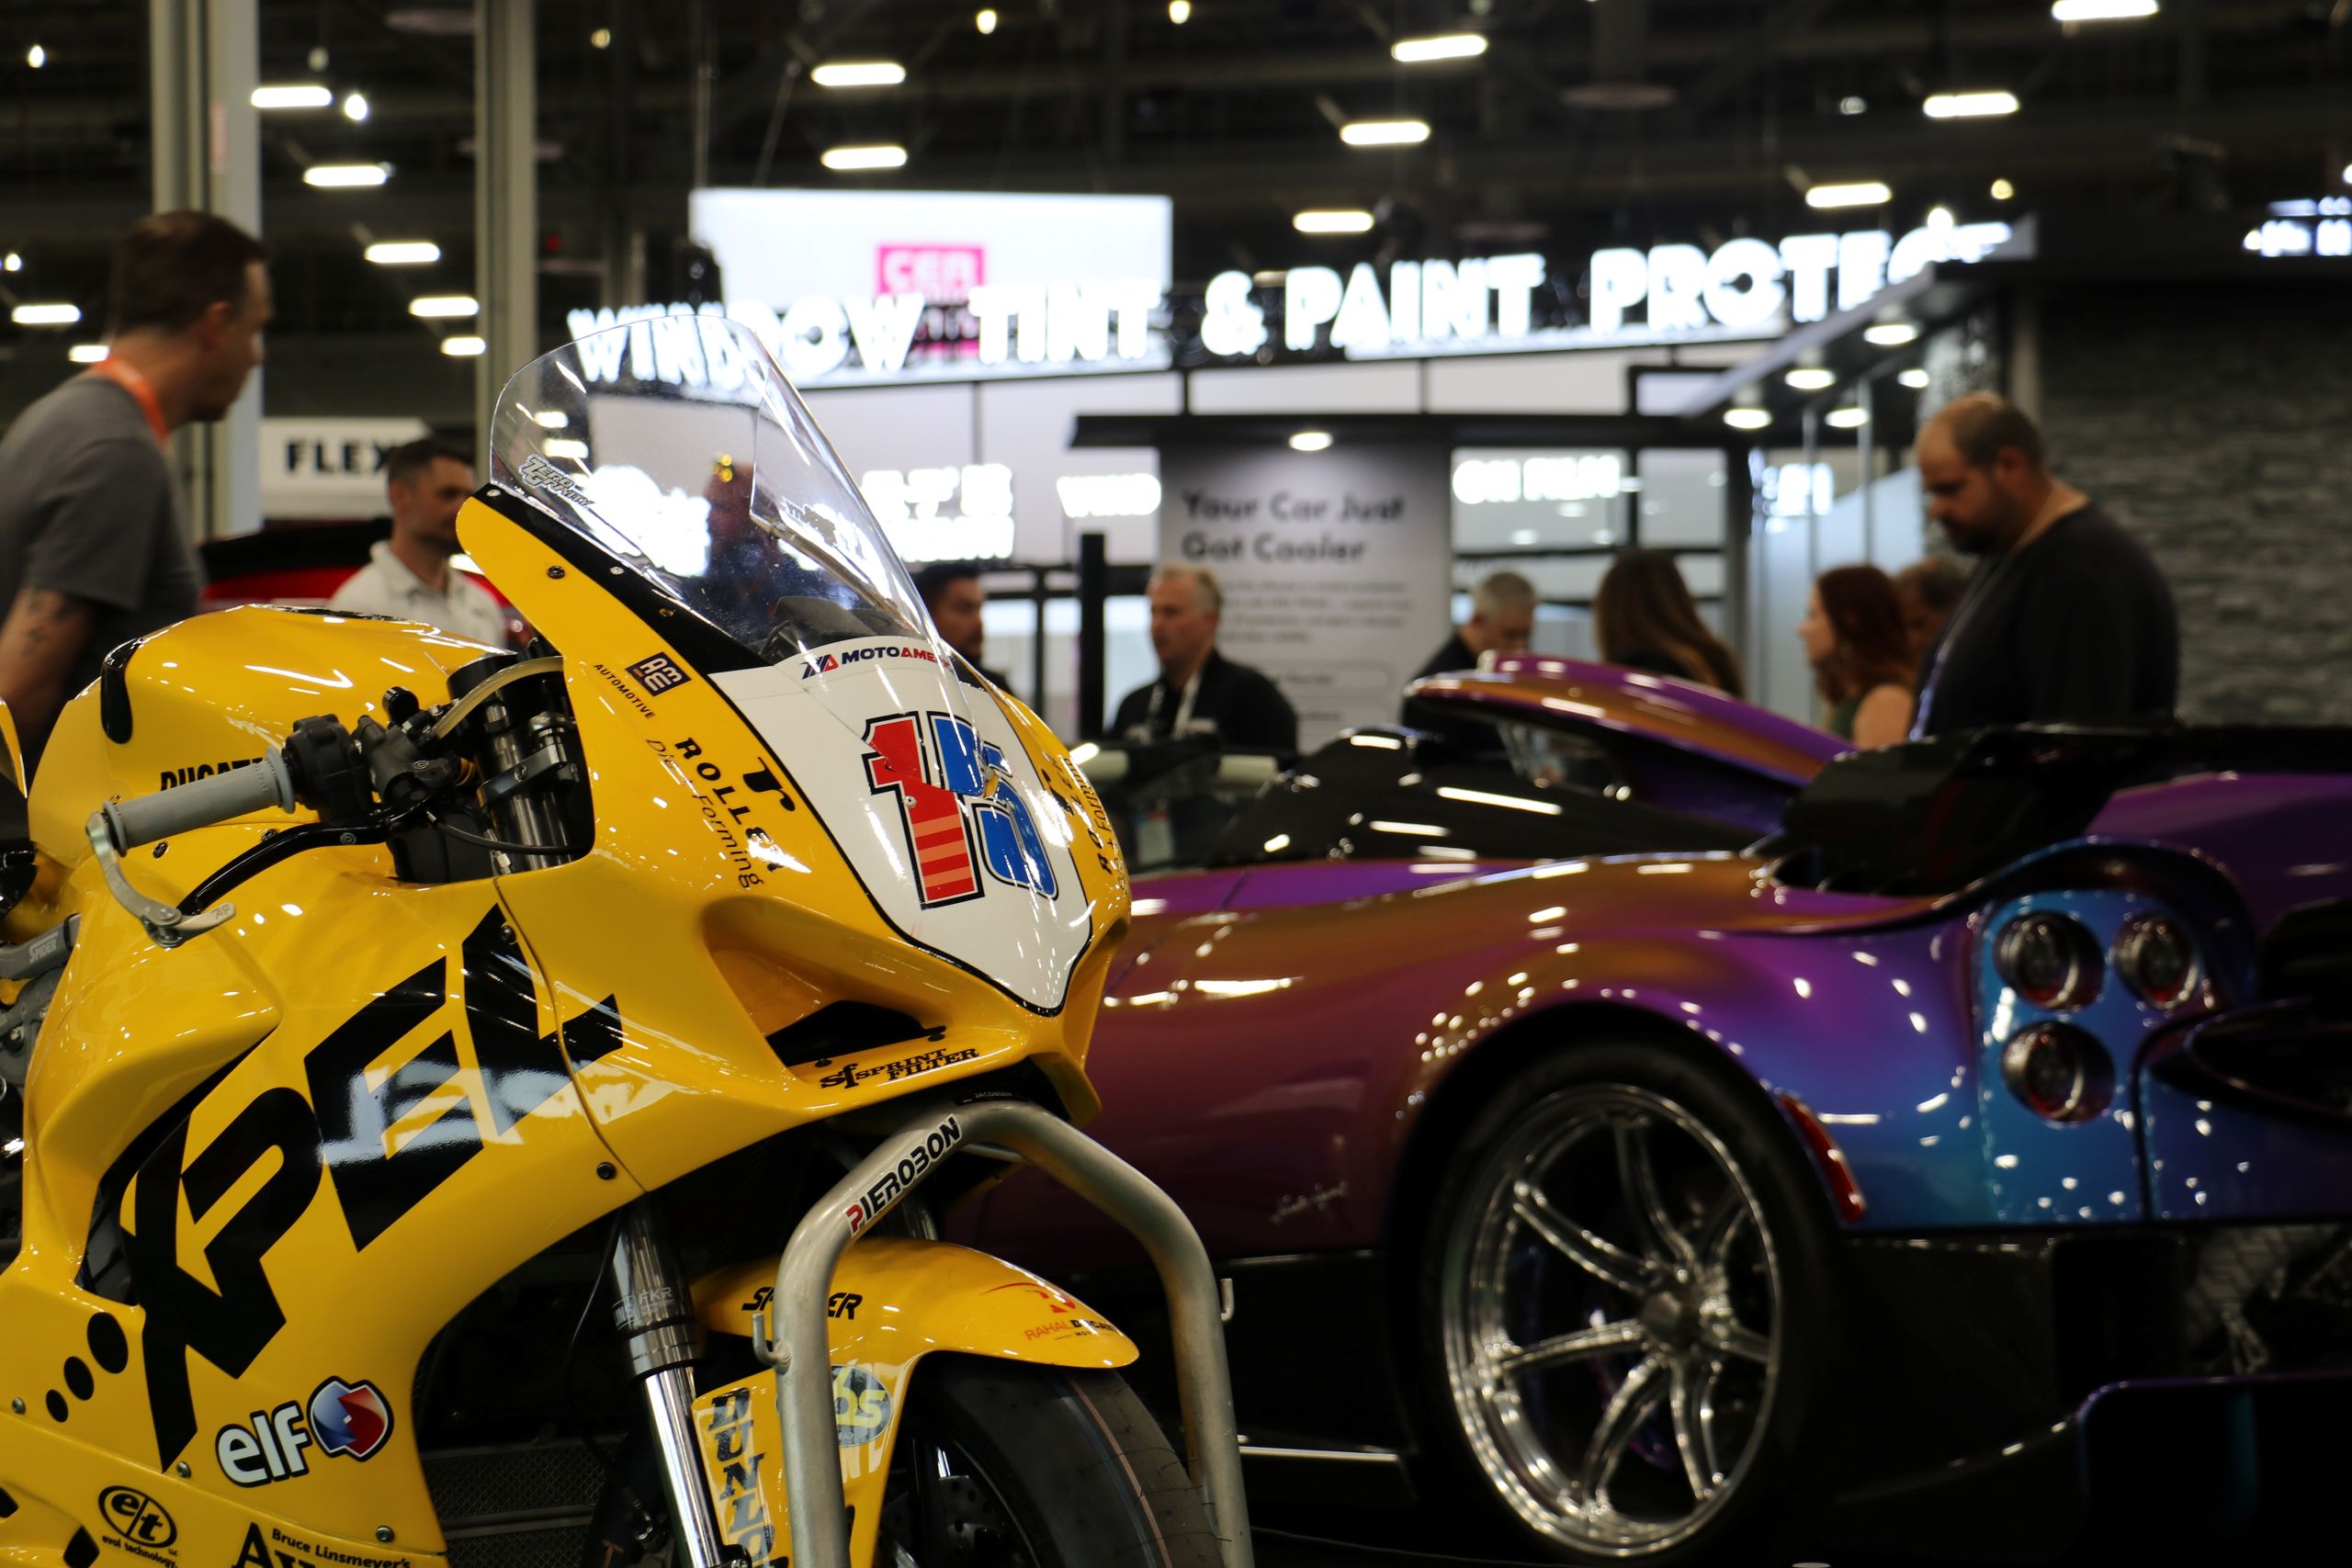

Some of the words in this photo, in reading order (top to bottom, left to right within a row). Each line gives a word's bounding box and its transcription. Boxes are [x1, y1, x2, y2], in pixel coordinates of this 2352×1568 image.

[567, 295, 924, 387] WINDOW
[969, 279, 1161, 365] TINT
[1201, 270, 1269, 356] &
[1284, 254, 1546, 351] PAINT
[521, 457, 575, 489] ZERO
[1182, 491, 1257, 520] Your
[1269, 490, 1327, 521] Car
[1340, 491, 1406, 522] Just
[1182, 532, 1243, 561] Got
[1255, 532, 1364, 561] Cooler
[594, 664, 656, 719] AUTOMOTIVE
[861, 711, 1059, 911] 15
[692, 795, 764, 889] Forming
[855, 1048, 946, 1080] SPRINT
[888, 1048, 980, 1081] FILTER
[120, 903, 624, 1474] XPEL
[845, 1116, 961, 1234] PIEROBON
[1024, 1323, 1073, 1340] RAHAL
[217, 1403, 311, 1485] elf
[707, 1387, 789, 1568] DUNLO
[272, 1529, 311, 1552] Bruce
[315, 1544, 412, 1568] Linsmeyer's
